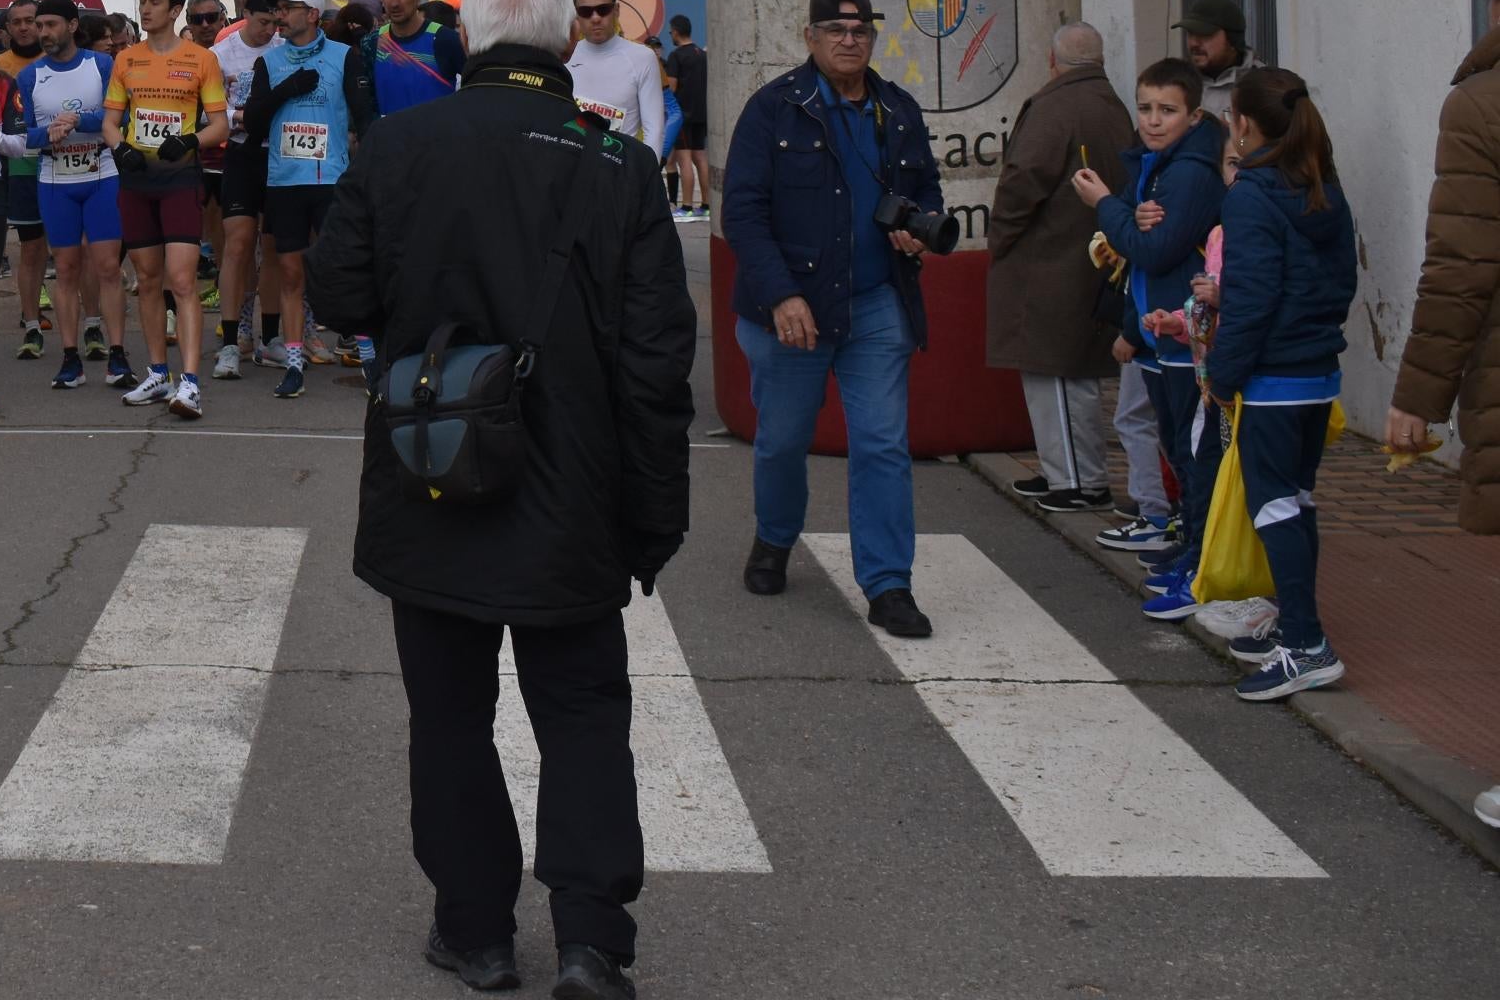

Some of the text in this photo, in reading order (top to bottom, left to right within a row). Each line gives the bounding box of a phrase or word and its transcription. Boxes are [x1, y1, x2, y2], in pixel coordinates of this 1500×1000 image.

[508, 71, 544, 87] Nikon
[136, 110, 181, 123] bedunia
[143, 122, 171, 138] 166
[283, 124, 327, 135] bedunia
[289, 134, 317, 150] 143
[62, 153, 91, 168] 154
